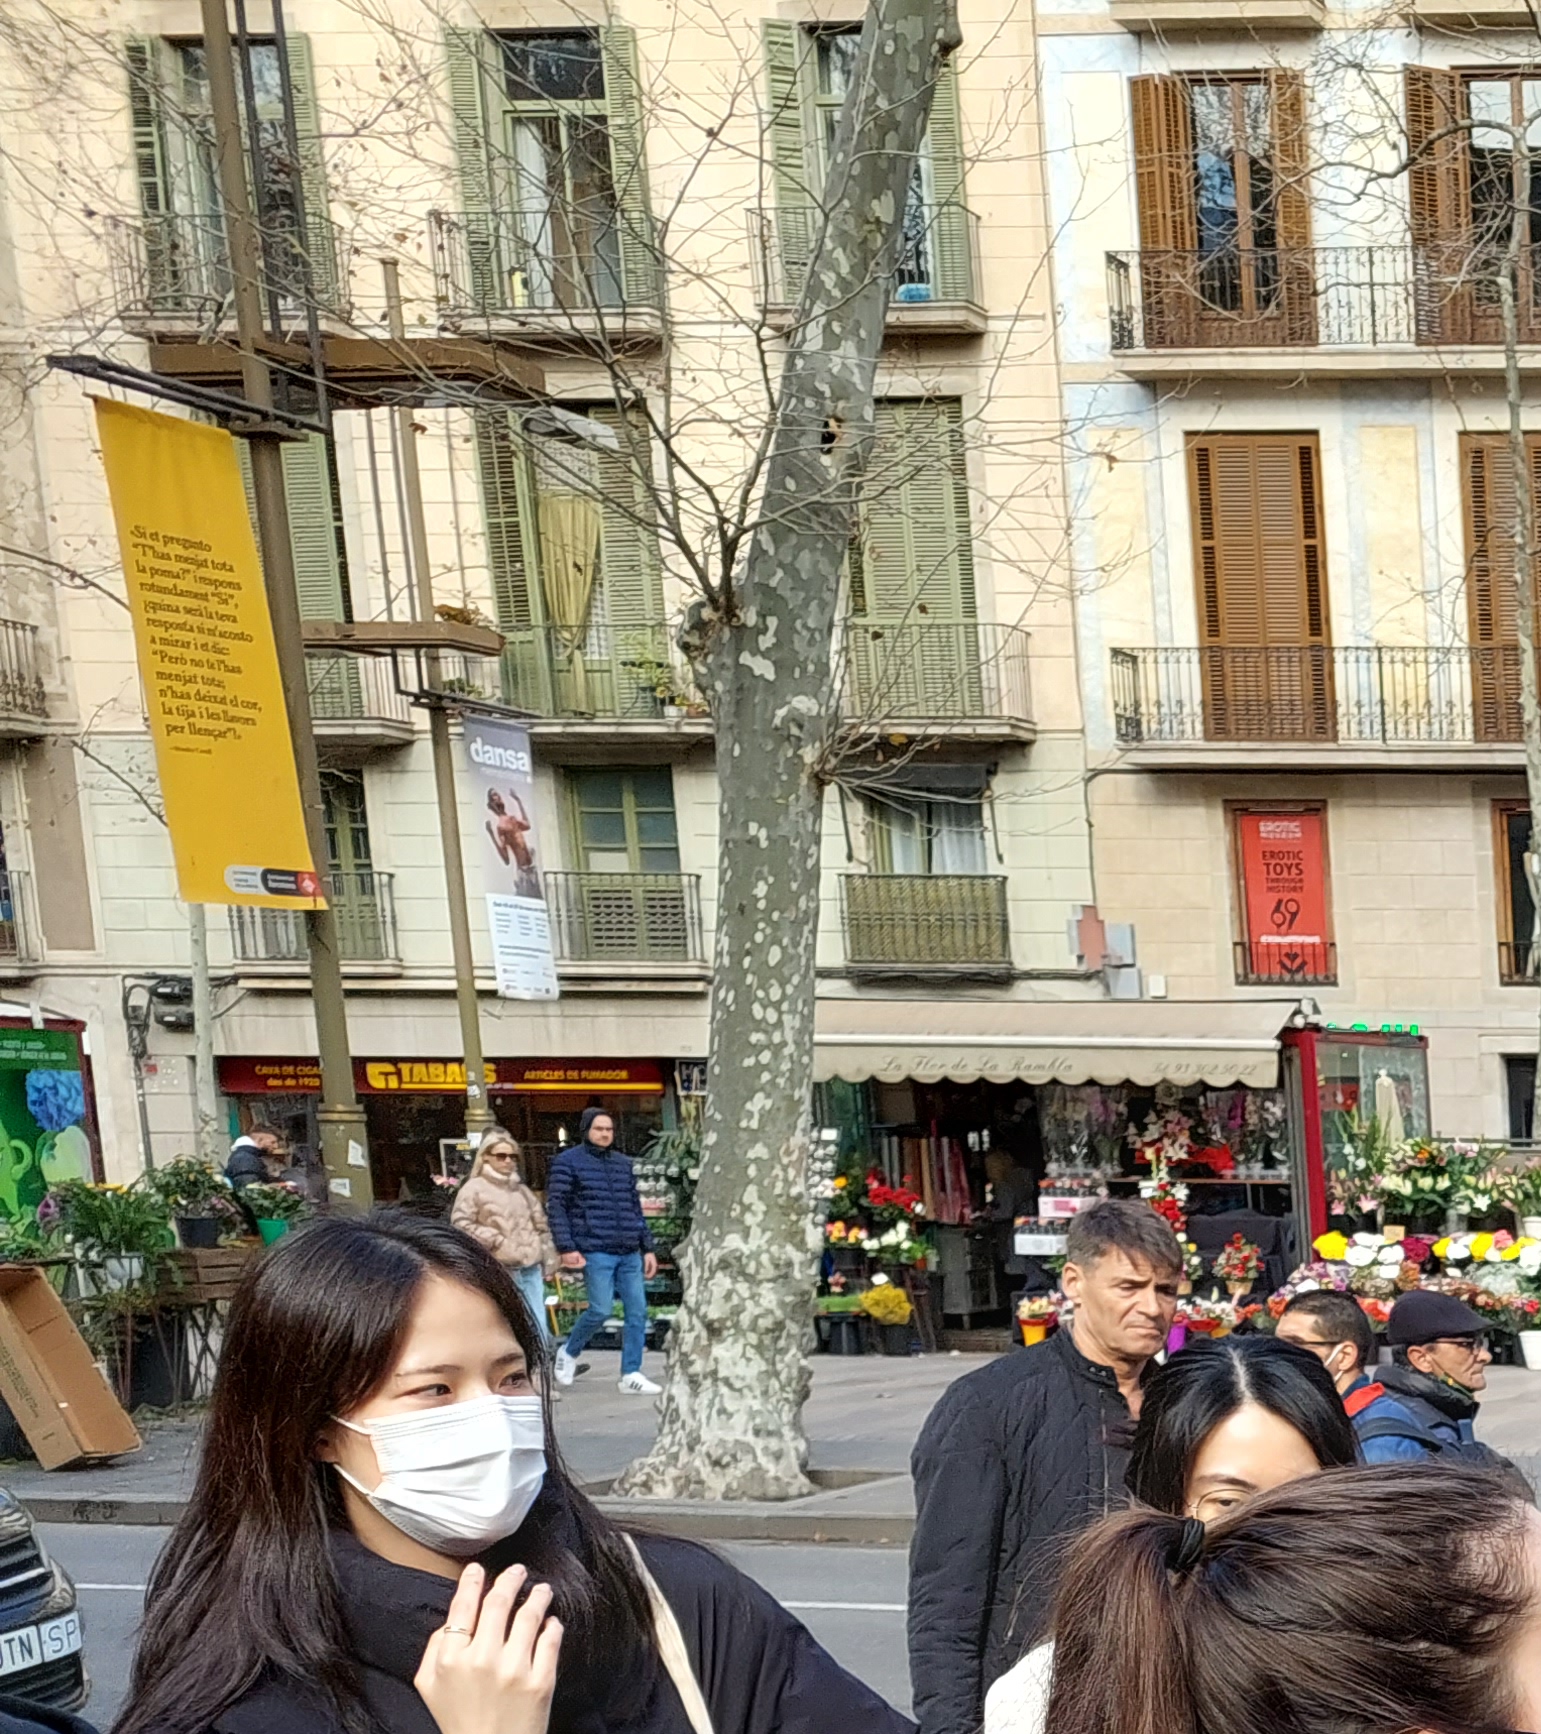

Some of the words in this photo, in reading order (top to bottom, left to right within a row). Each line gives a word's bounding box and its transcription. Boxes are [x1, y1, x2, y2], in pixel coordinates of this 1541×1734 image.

[211, 559, 235, 573] tota
[215, 610, 238, 624] teva
[146, 617, 195, 633] resposta
[159, 634, 191, 650] mirar
[190, 656, 204, 668] no
[155, 670, 199, 687] menjat
[161, 701, 173, 716] la
[165, 723, 185, 736] per
[470, 736, 530, 773] dansa
[1262, 851, 1304, 861] EROTIC
[1263, 862, 1304, 876] TOYS
[912, 1055, 946, 1072] Flor
[951, 1057, 969, 1072] de
[1010, 1056, 1073, 1072] Rambla
[397, 1062, 497, 1084] TABAS
[48, 1618, 77, 1654] SP
